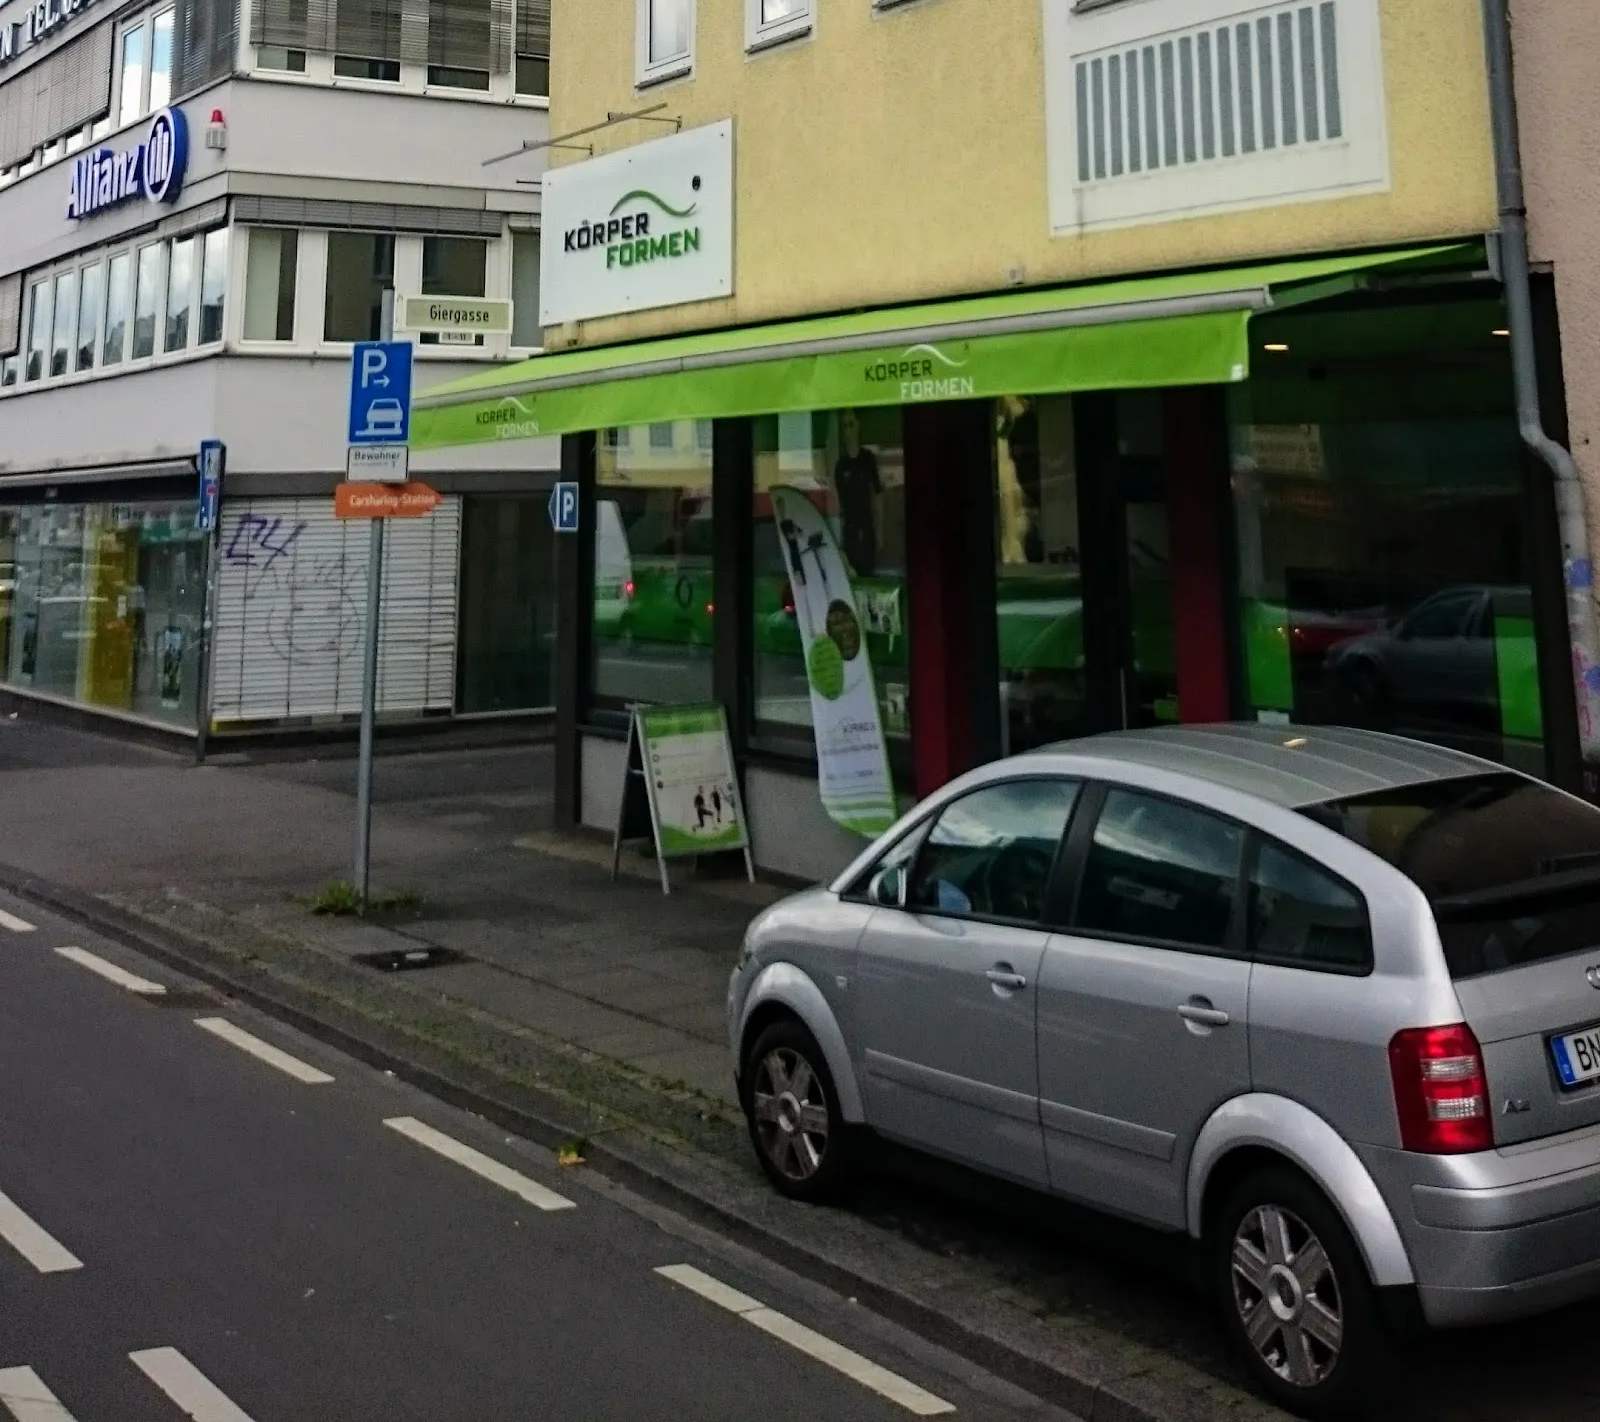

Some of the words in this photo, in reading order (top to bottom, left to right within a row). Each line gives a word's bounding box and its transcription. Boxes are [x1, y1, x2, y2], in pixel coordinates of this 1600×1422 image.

[66, 145, 142, 219] Allianz
[564, 212, 649, 252] KÖRPER
[606, 227, 700, 269] FORMEN
[429, 304, 490, 324] Giergasse
[361, 348, 387, 389] P
[863, 358, 933, 383] KÖRPER
[901, 376, 974, 399] FORMEN
[354, 450, 402, 460] Bewohner
[562, 490, 575, 522] P
